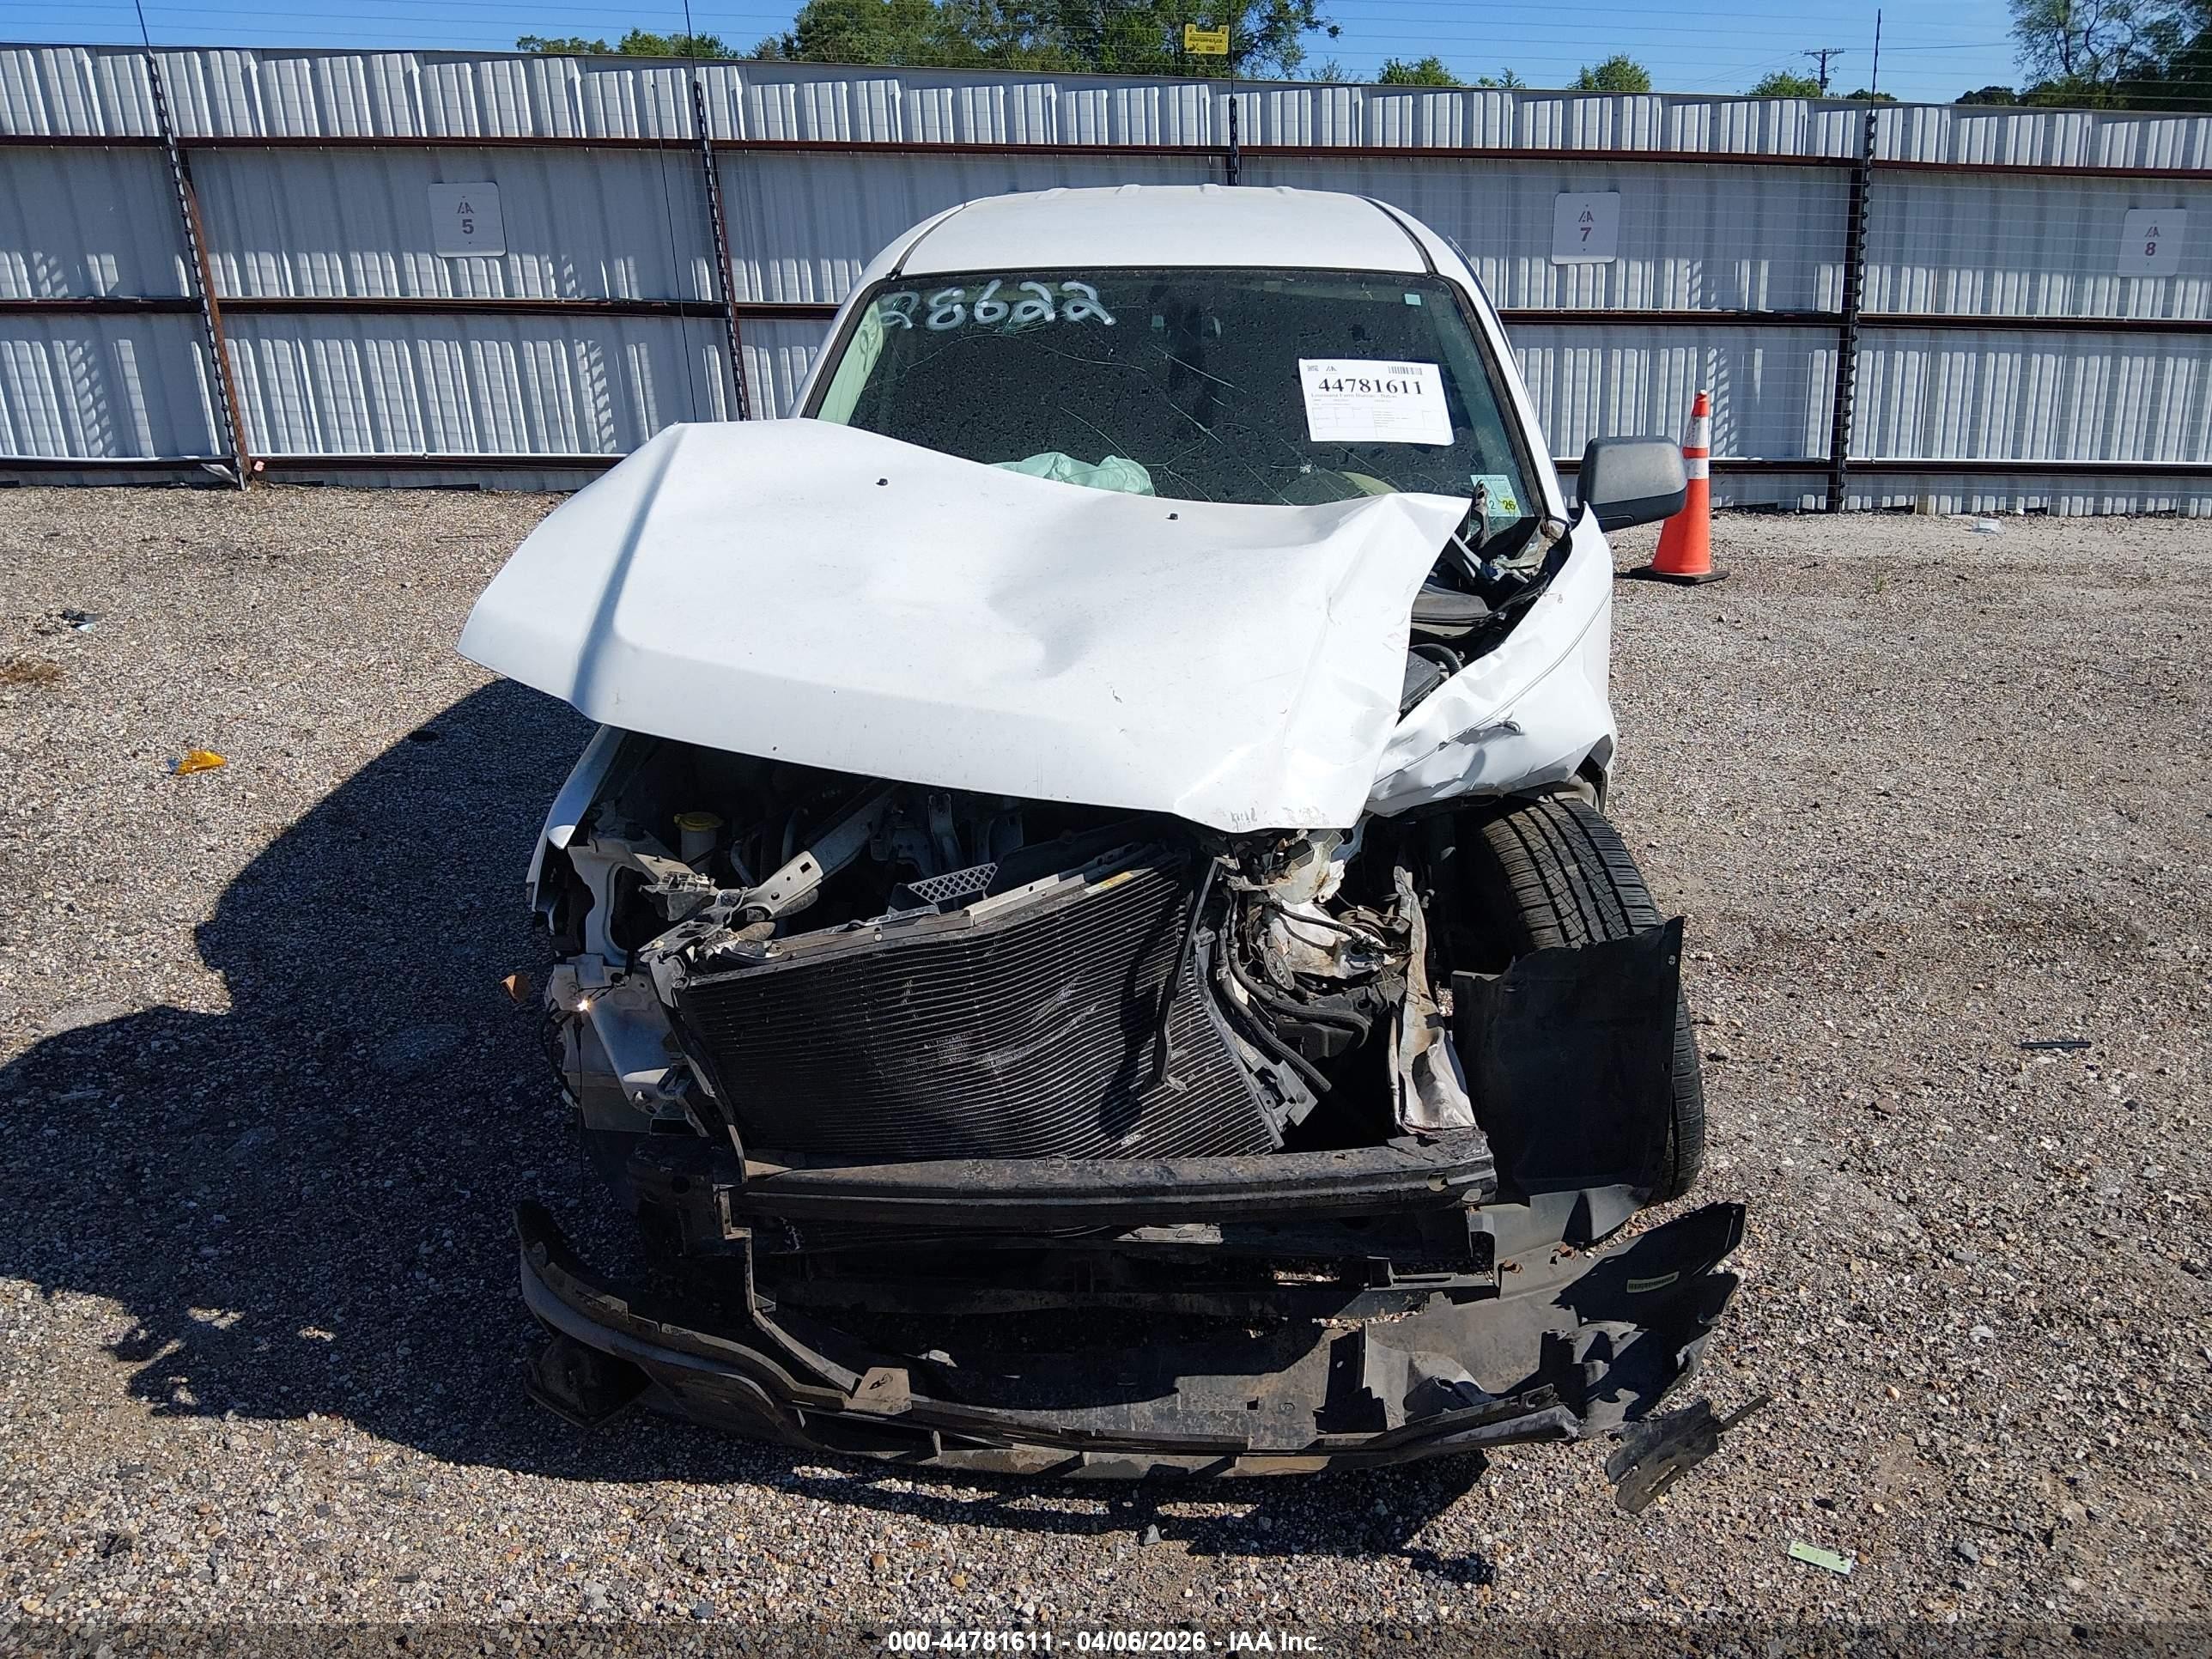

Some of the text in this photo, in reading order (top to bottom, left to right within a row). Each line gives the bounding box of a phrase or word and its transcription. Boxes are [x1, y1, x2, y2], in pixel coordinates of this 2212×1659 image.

[462, 219, 474, 234] 5
[1580, 227, 1592, 242] 7
[2145, 241, 2156, 256] 8
[879, 279, 1117, 331] 28622
[1318, 377, 1424, 395] 44781611
[1503, 500, 1516, 510] 26
